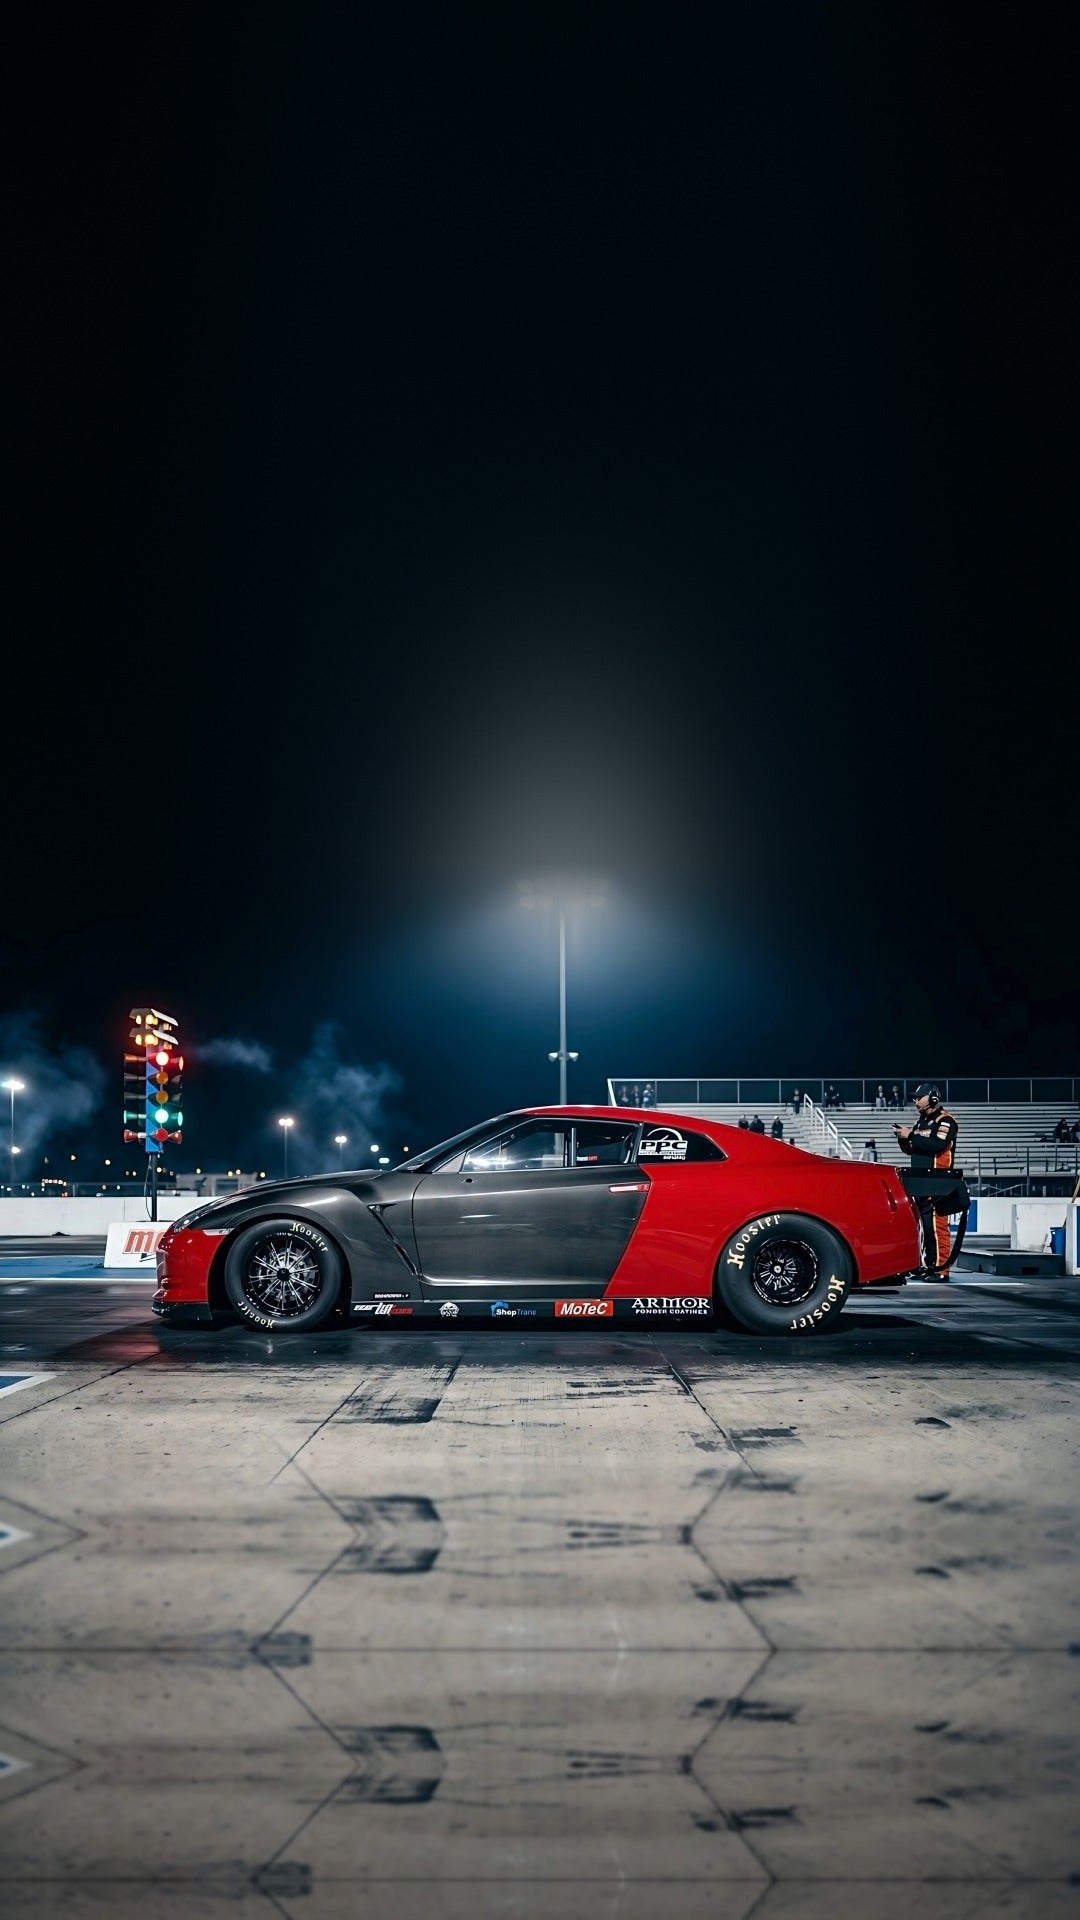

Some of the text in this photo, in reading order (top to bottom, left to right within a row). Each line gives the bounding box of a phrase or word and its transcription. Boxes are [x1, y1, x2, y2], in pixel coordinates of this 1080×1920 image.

[640, 1141, 687, 1154] PPC
[726, 1214, 781, 1270] Hoosier
[632, 1297, 711, 1309] ARMOR
[790, 1274, 846, 1330] Hoosier
[561, 1303, 608, 1315] MoTeC
